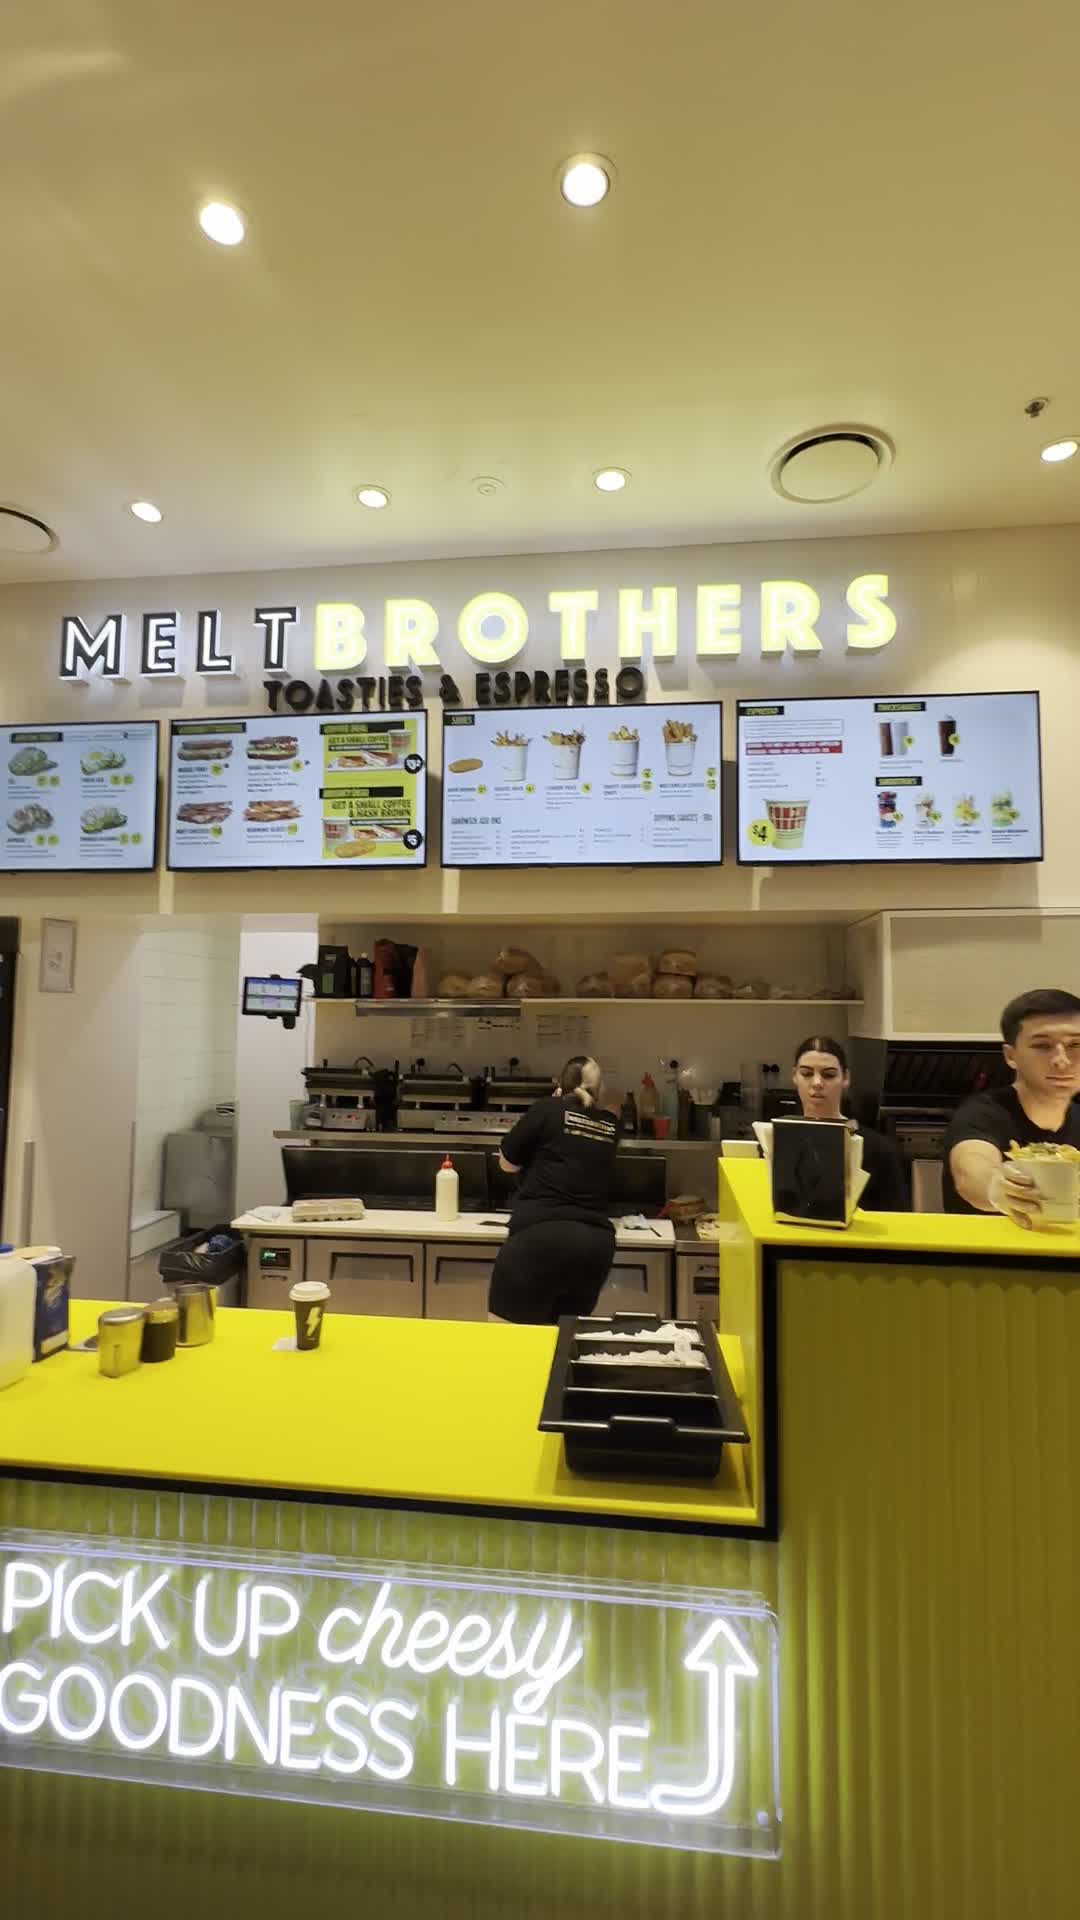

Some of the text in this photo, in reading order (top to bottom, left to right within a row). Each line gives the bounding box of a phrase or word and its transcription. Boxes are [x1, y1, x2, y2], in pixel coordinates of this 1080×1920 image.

[59, 574, 898, 680] MELT BROTHERS
[263, 667, 645, 712] TOASTIES & ESPRESSO
[752, 824, 768, 842] $4
[2, 1562, 583, 1711] PICK UP cheesy
[0, 1662, 652, 1810] GOODNESS HERE
